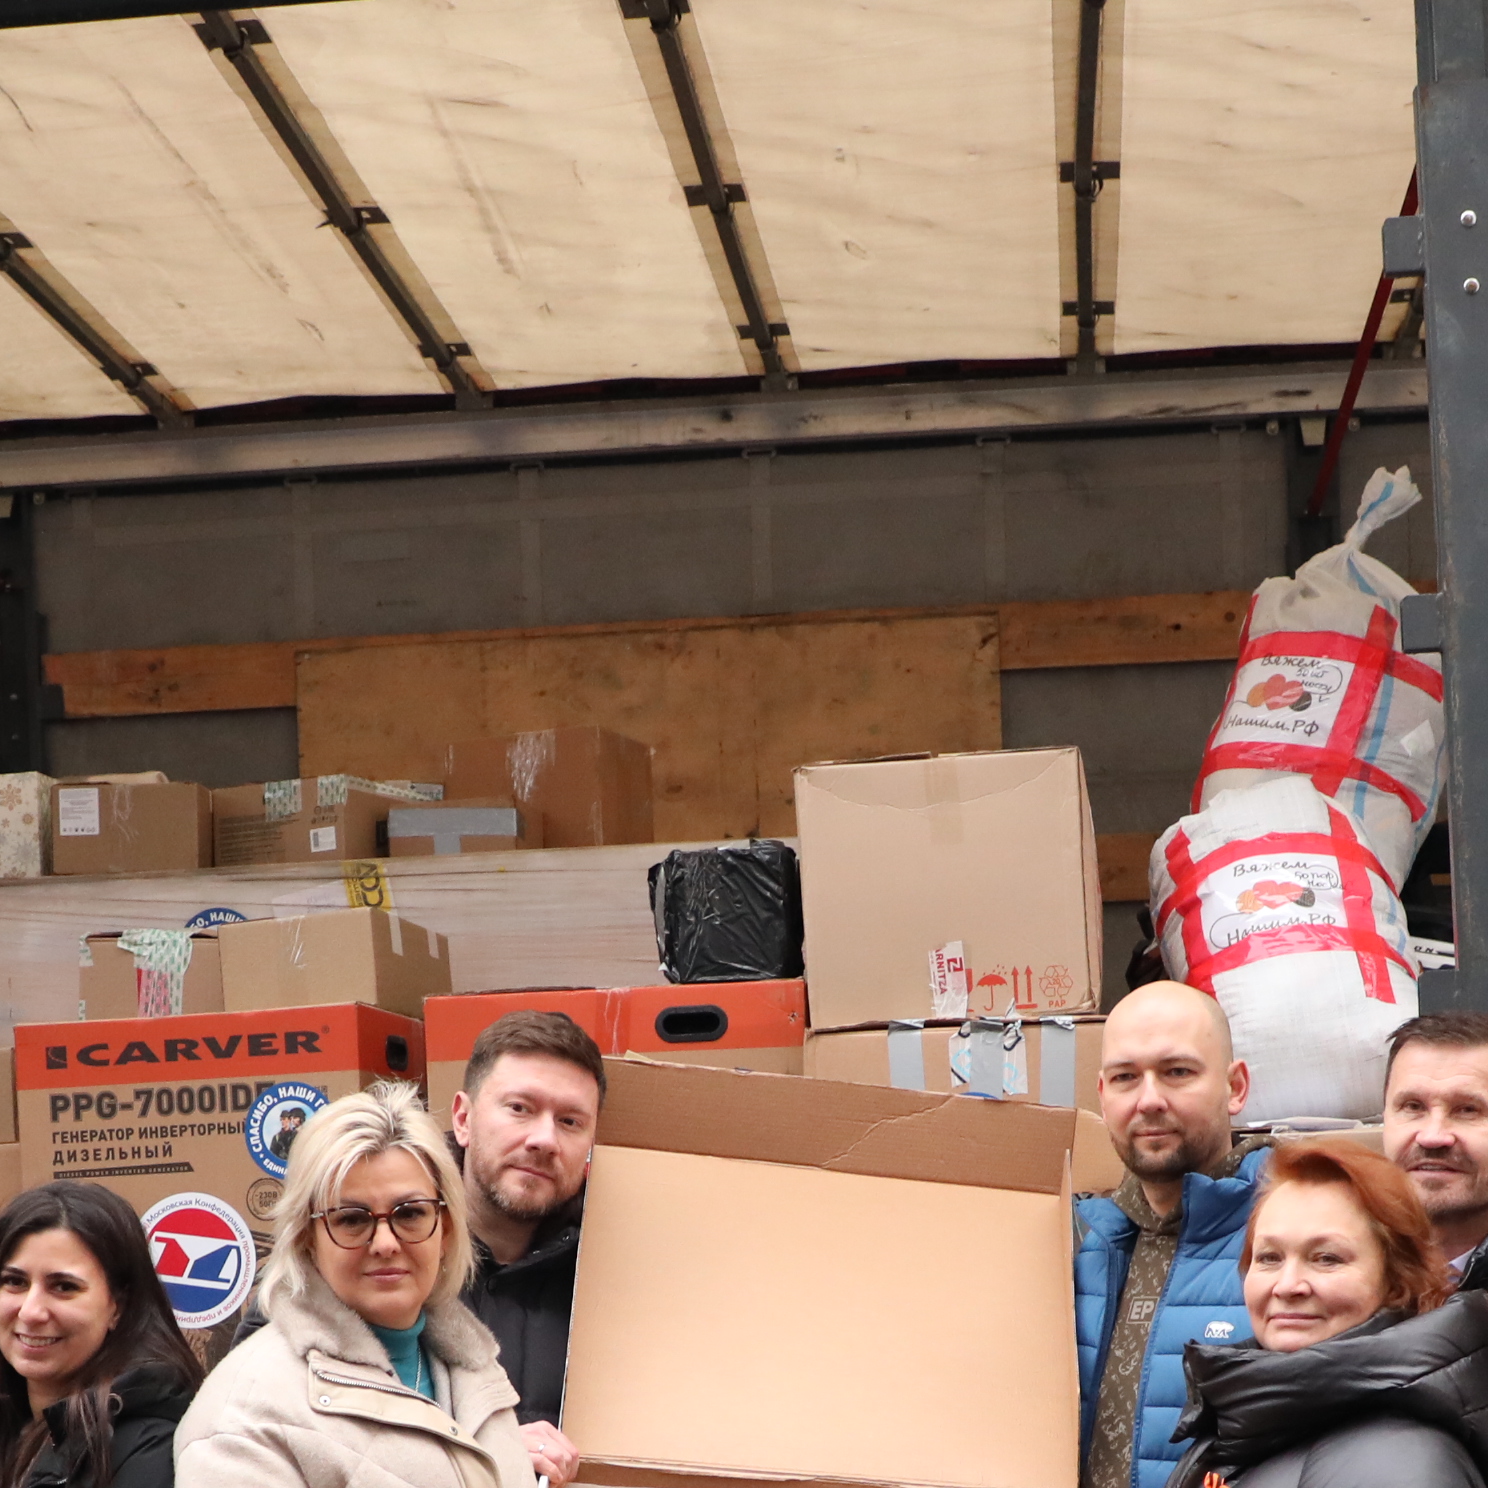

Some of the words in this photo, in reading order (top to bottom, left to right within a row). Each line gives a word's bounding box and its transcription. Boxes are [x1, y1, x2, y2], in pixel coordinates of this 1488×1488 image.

[1260, 655, 1322, 668] Вяжем
[1233, 861, 1310, 877] Вяжем
[1048, 1000, 1067, 1008] PAP
[76, 1030, 323, 1068] CARVER
[249, 1094, 278, 1153] СПАСИБО,
[278, 1085, 316, 1102] НАШИ
[52, 1127, 135, 1145] ГЕНЕРАТОР
[52, 1143, 173, 1166] ДИЗЕЛЬНЫЙ
[148, 1165, 189, 1173] GENERATOR
[145, 1199, 193, 1225] Московская
[194, 1198, 246, 1240] Конфедерация
[223, 1239, 251, 1312] промышленников
